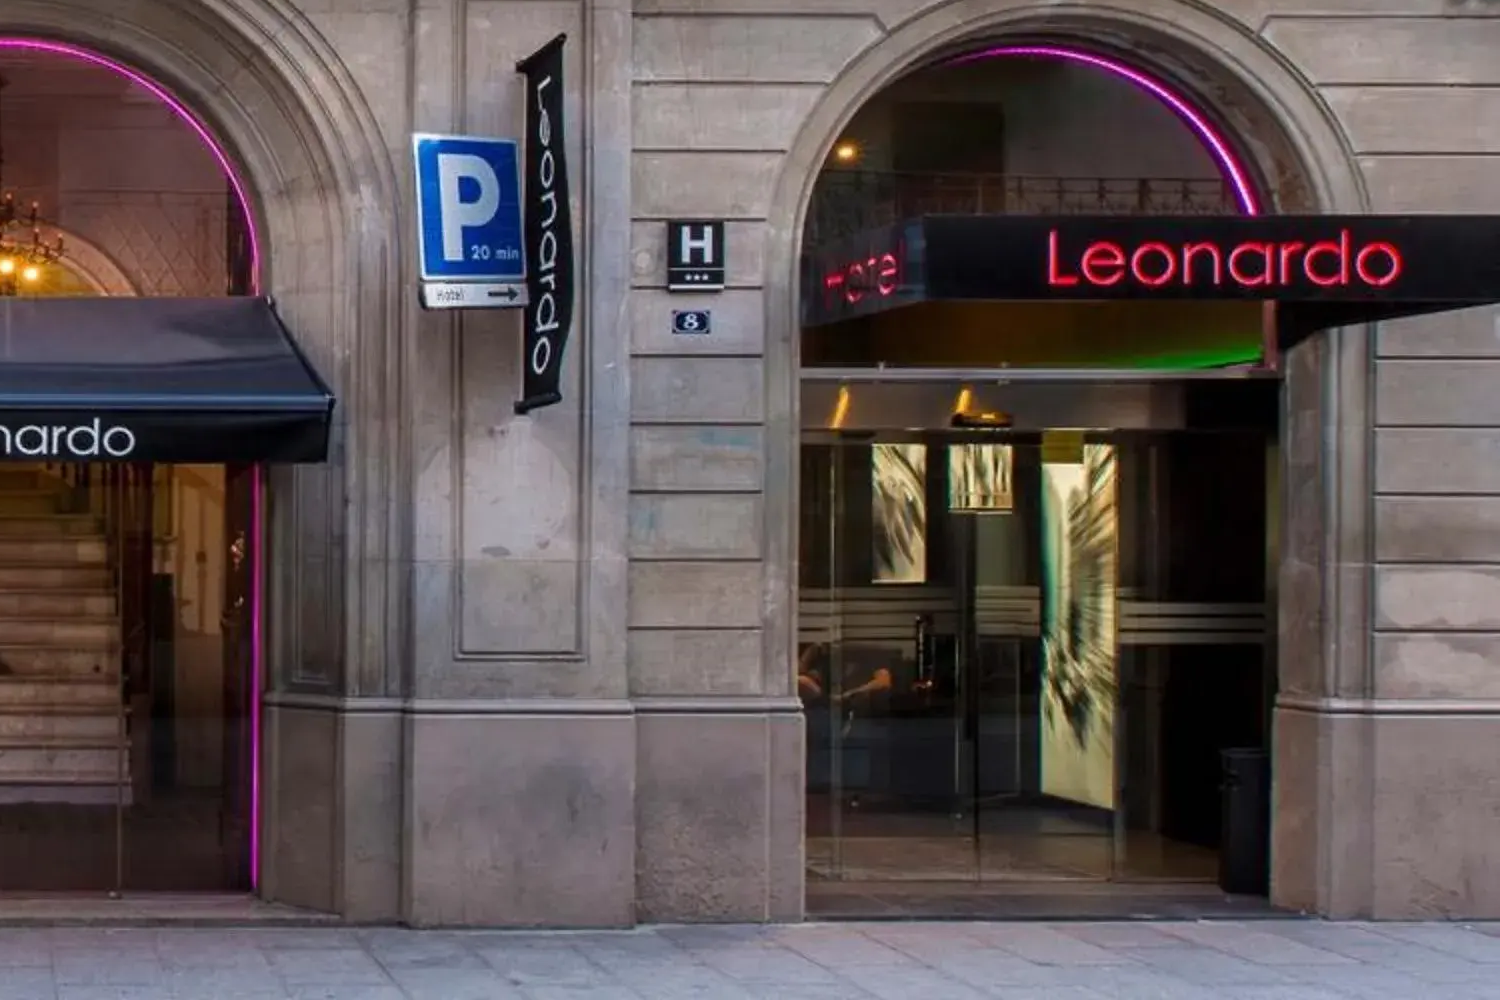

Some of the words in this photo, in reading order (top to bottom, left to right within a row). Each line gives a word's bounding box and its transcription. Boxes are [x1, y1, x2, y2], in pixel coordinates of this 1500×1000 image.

[438, 153, 499, 260] P
[533, 76, 559, 374] Leonardo
[471, 245, 490, 260] 20
[496, 246, 519, 260] min
[681, 225, 712, 263] H
[1048, 229, 1401, 286] Leonardo
[683, 313, 699, 329] 8
